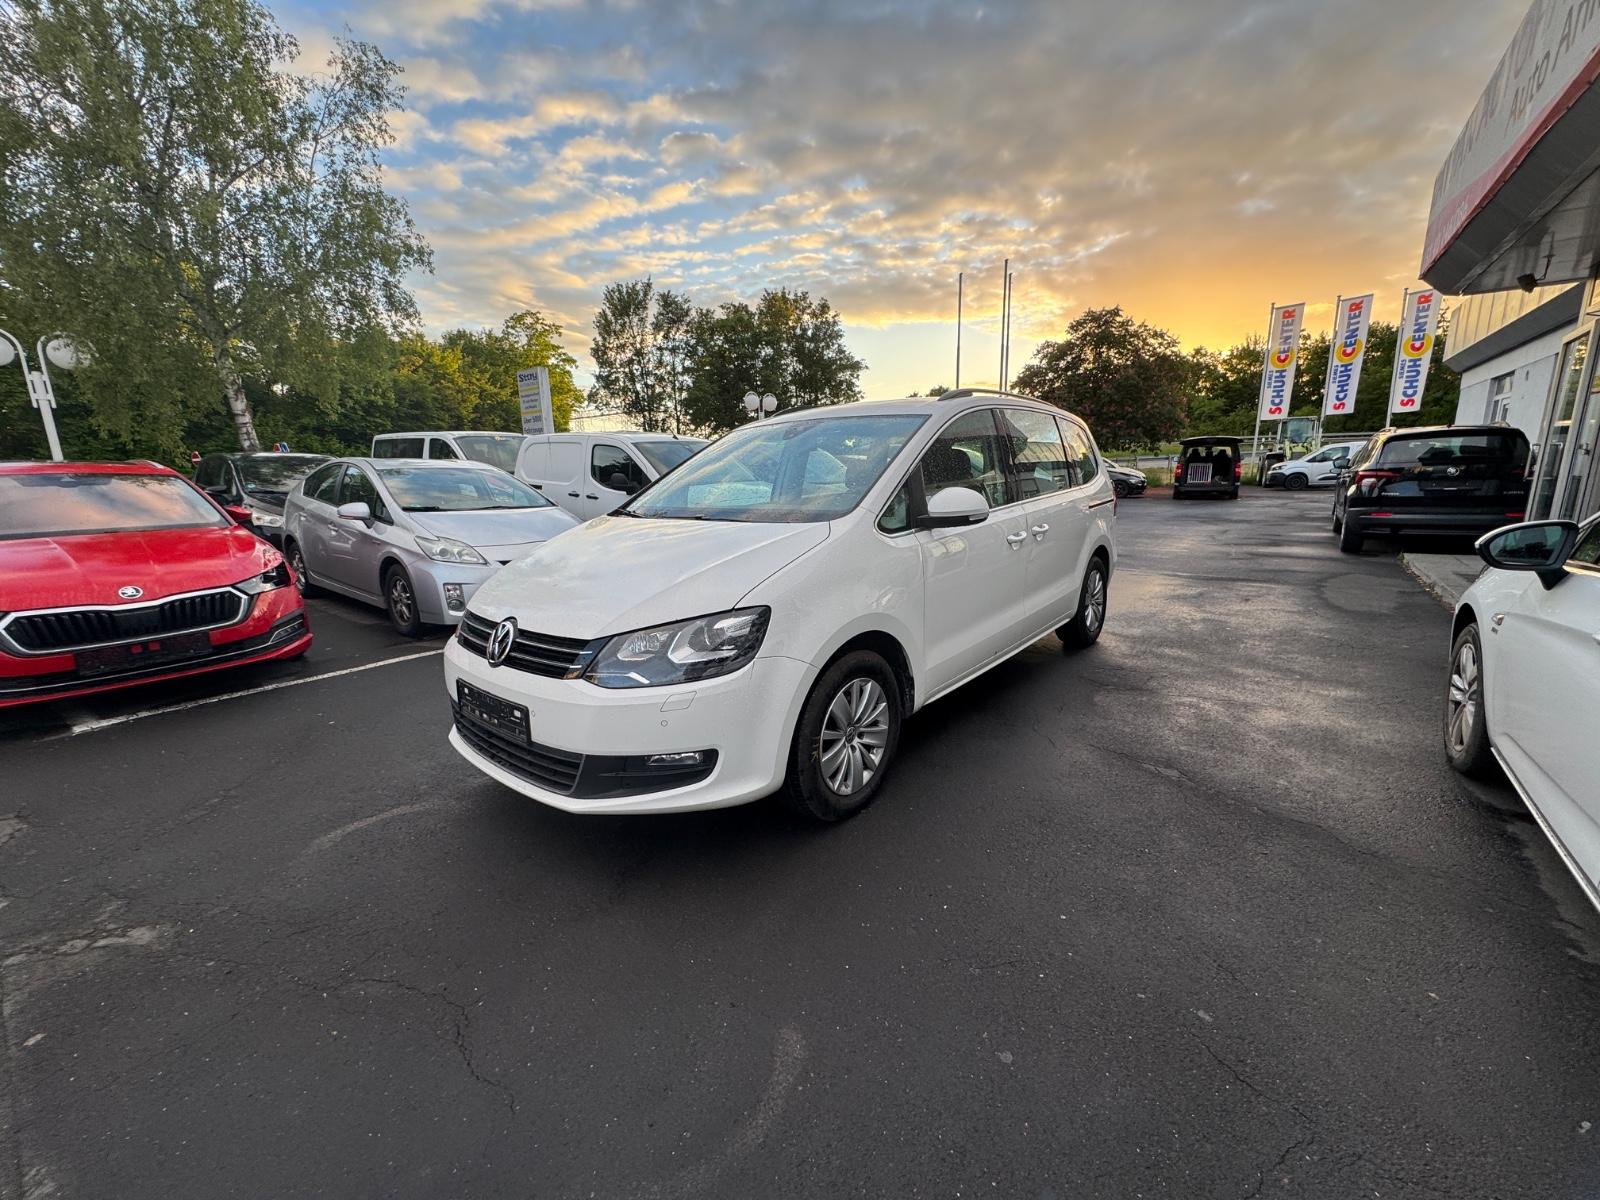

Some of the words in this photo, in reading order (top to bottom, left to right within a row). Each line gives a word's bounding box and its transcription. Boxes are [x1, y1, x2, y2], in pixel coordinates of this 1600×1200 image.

[1503, 50, 1551, 139] Auto
[1276, 307, 1297, 364] CENTER
[1341, 299, 1365, 358] CENTER
[1409, 291, 1434, 353] CENTER
[1268, 368, 1287, 415] SCHUH
[1333, 362, 1353, 411] SCHUH
[1400, 357, 1422, 407] SCHUH
